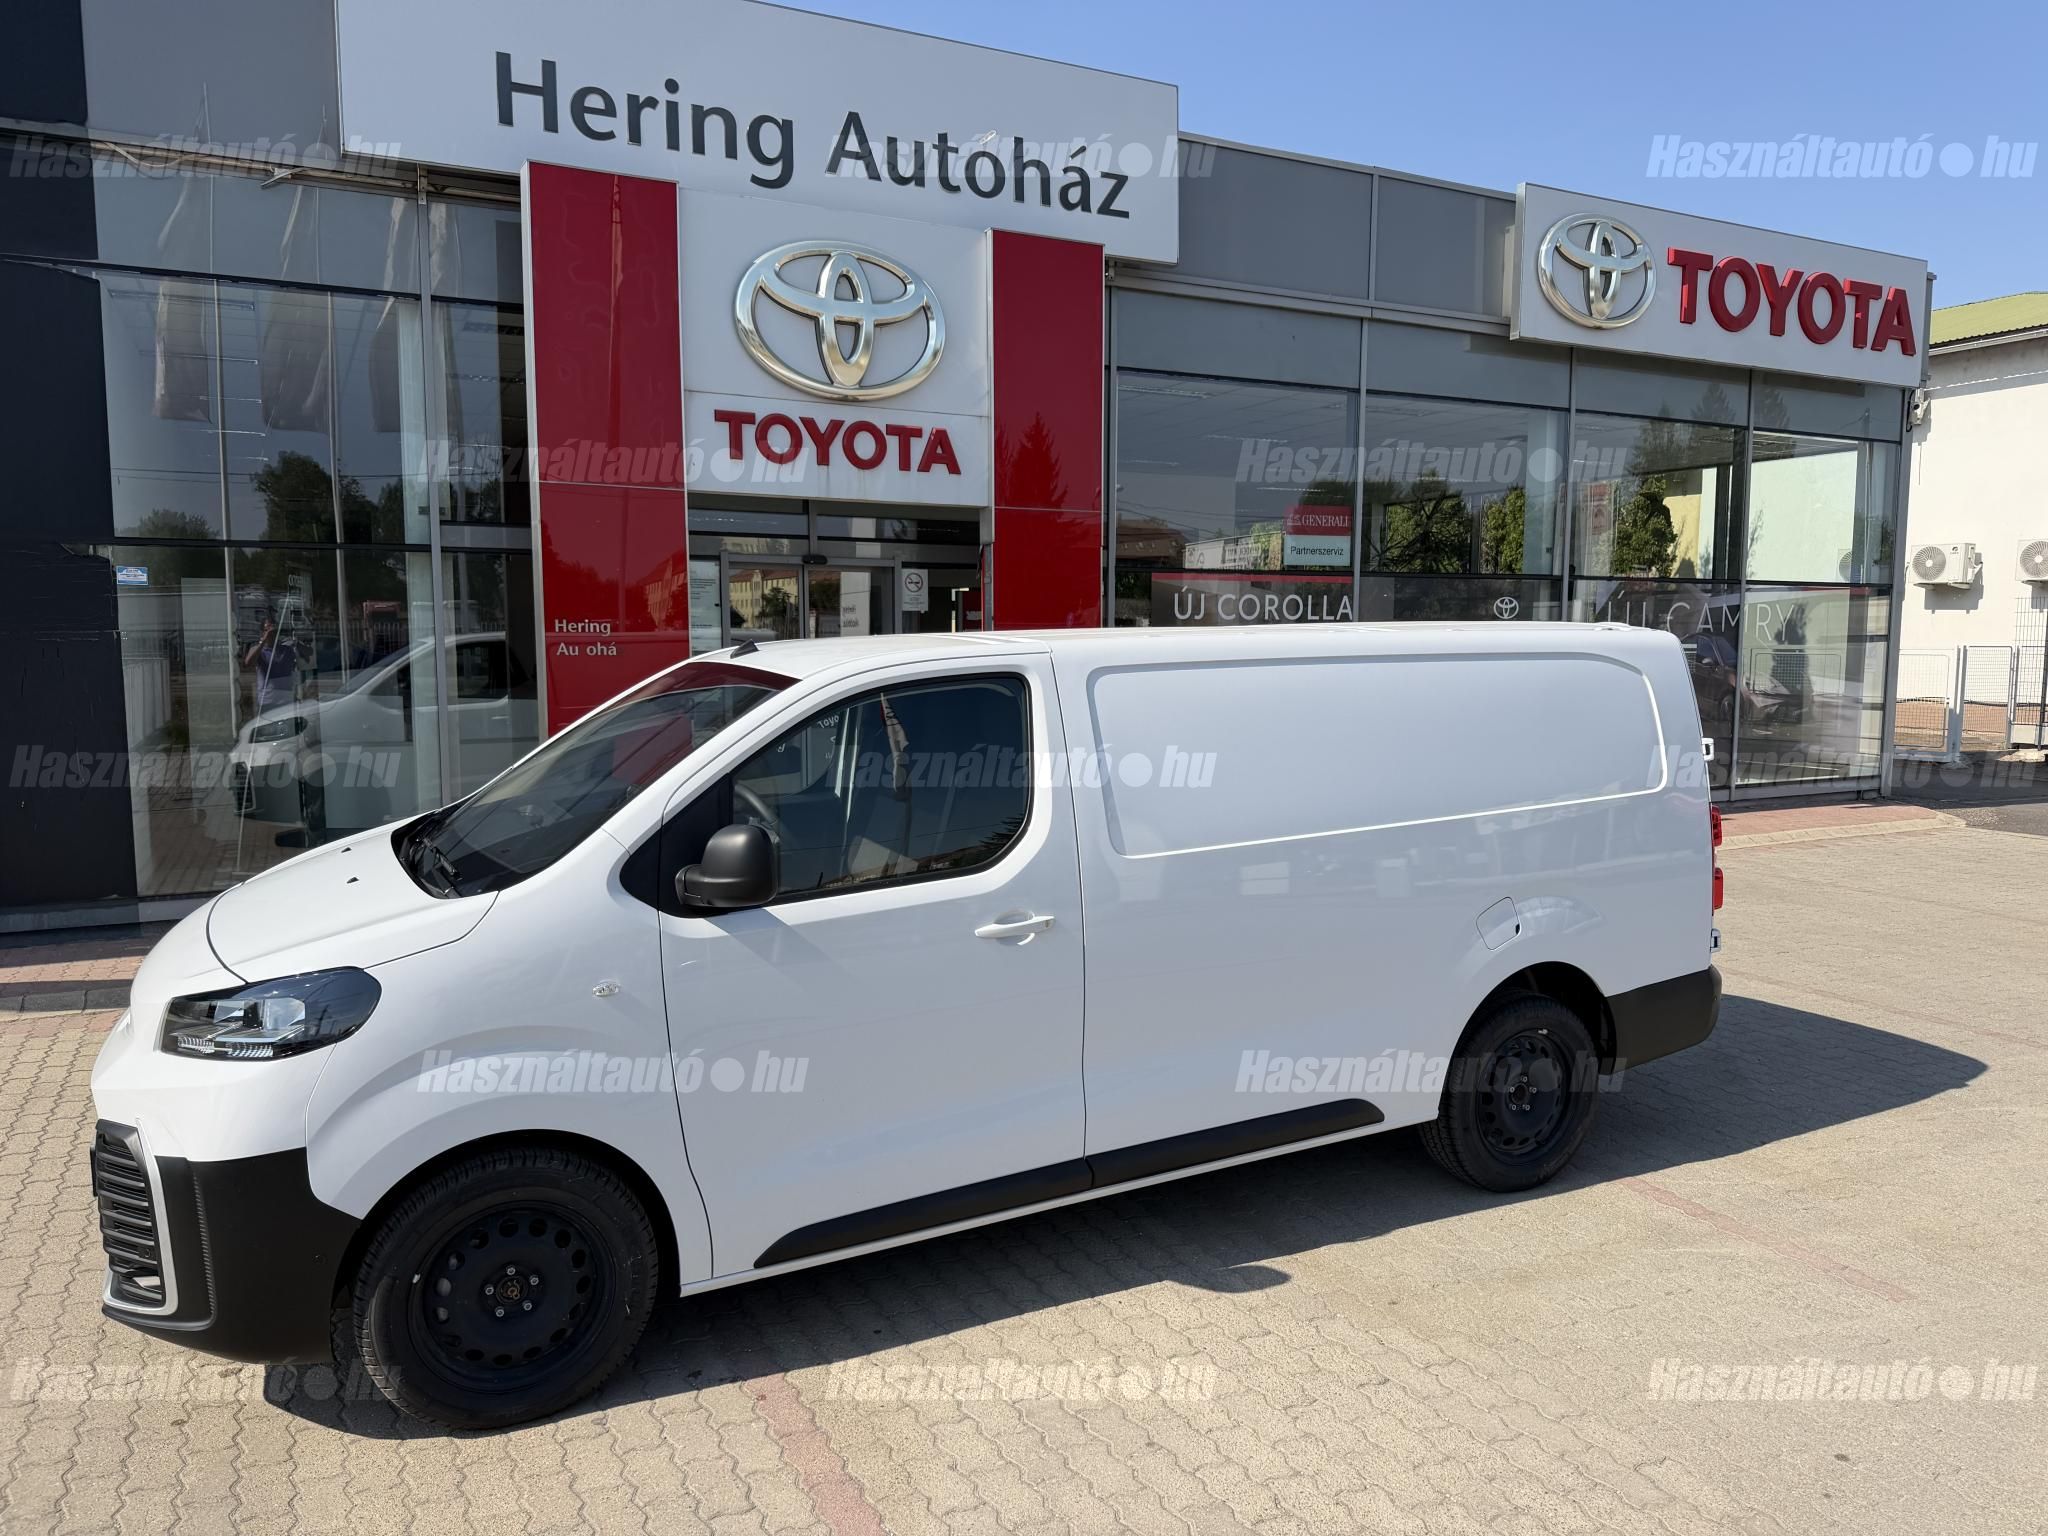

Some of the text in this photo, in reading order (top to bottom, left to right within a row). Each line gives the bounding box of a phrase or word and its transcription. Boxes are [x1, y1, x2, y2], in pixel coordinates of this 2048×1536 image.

[496, 51, 1129, 219] Hering Autóház
[1668, 247, 1916, 356] TOYOTA
[714, 409, 961, 474] TOYOTA
[1302, 514, 1348, 528] GENERALI
[1290, 546, 1344, 556] Partnerszerviz
[1174, 585, 1353, 620] ÚJ COROLLA
[554, 619, 611, 637] Hering
[1667, 602, 1794, 641] CAMRY
